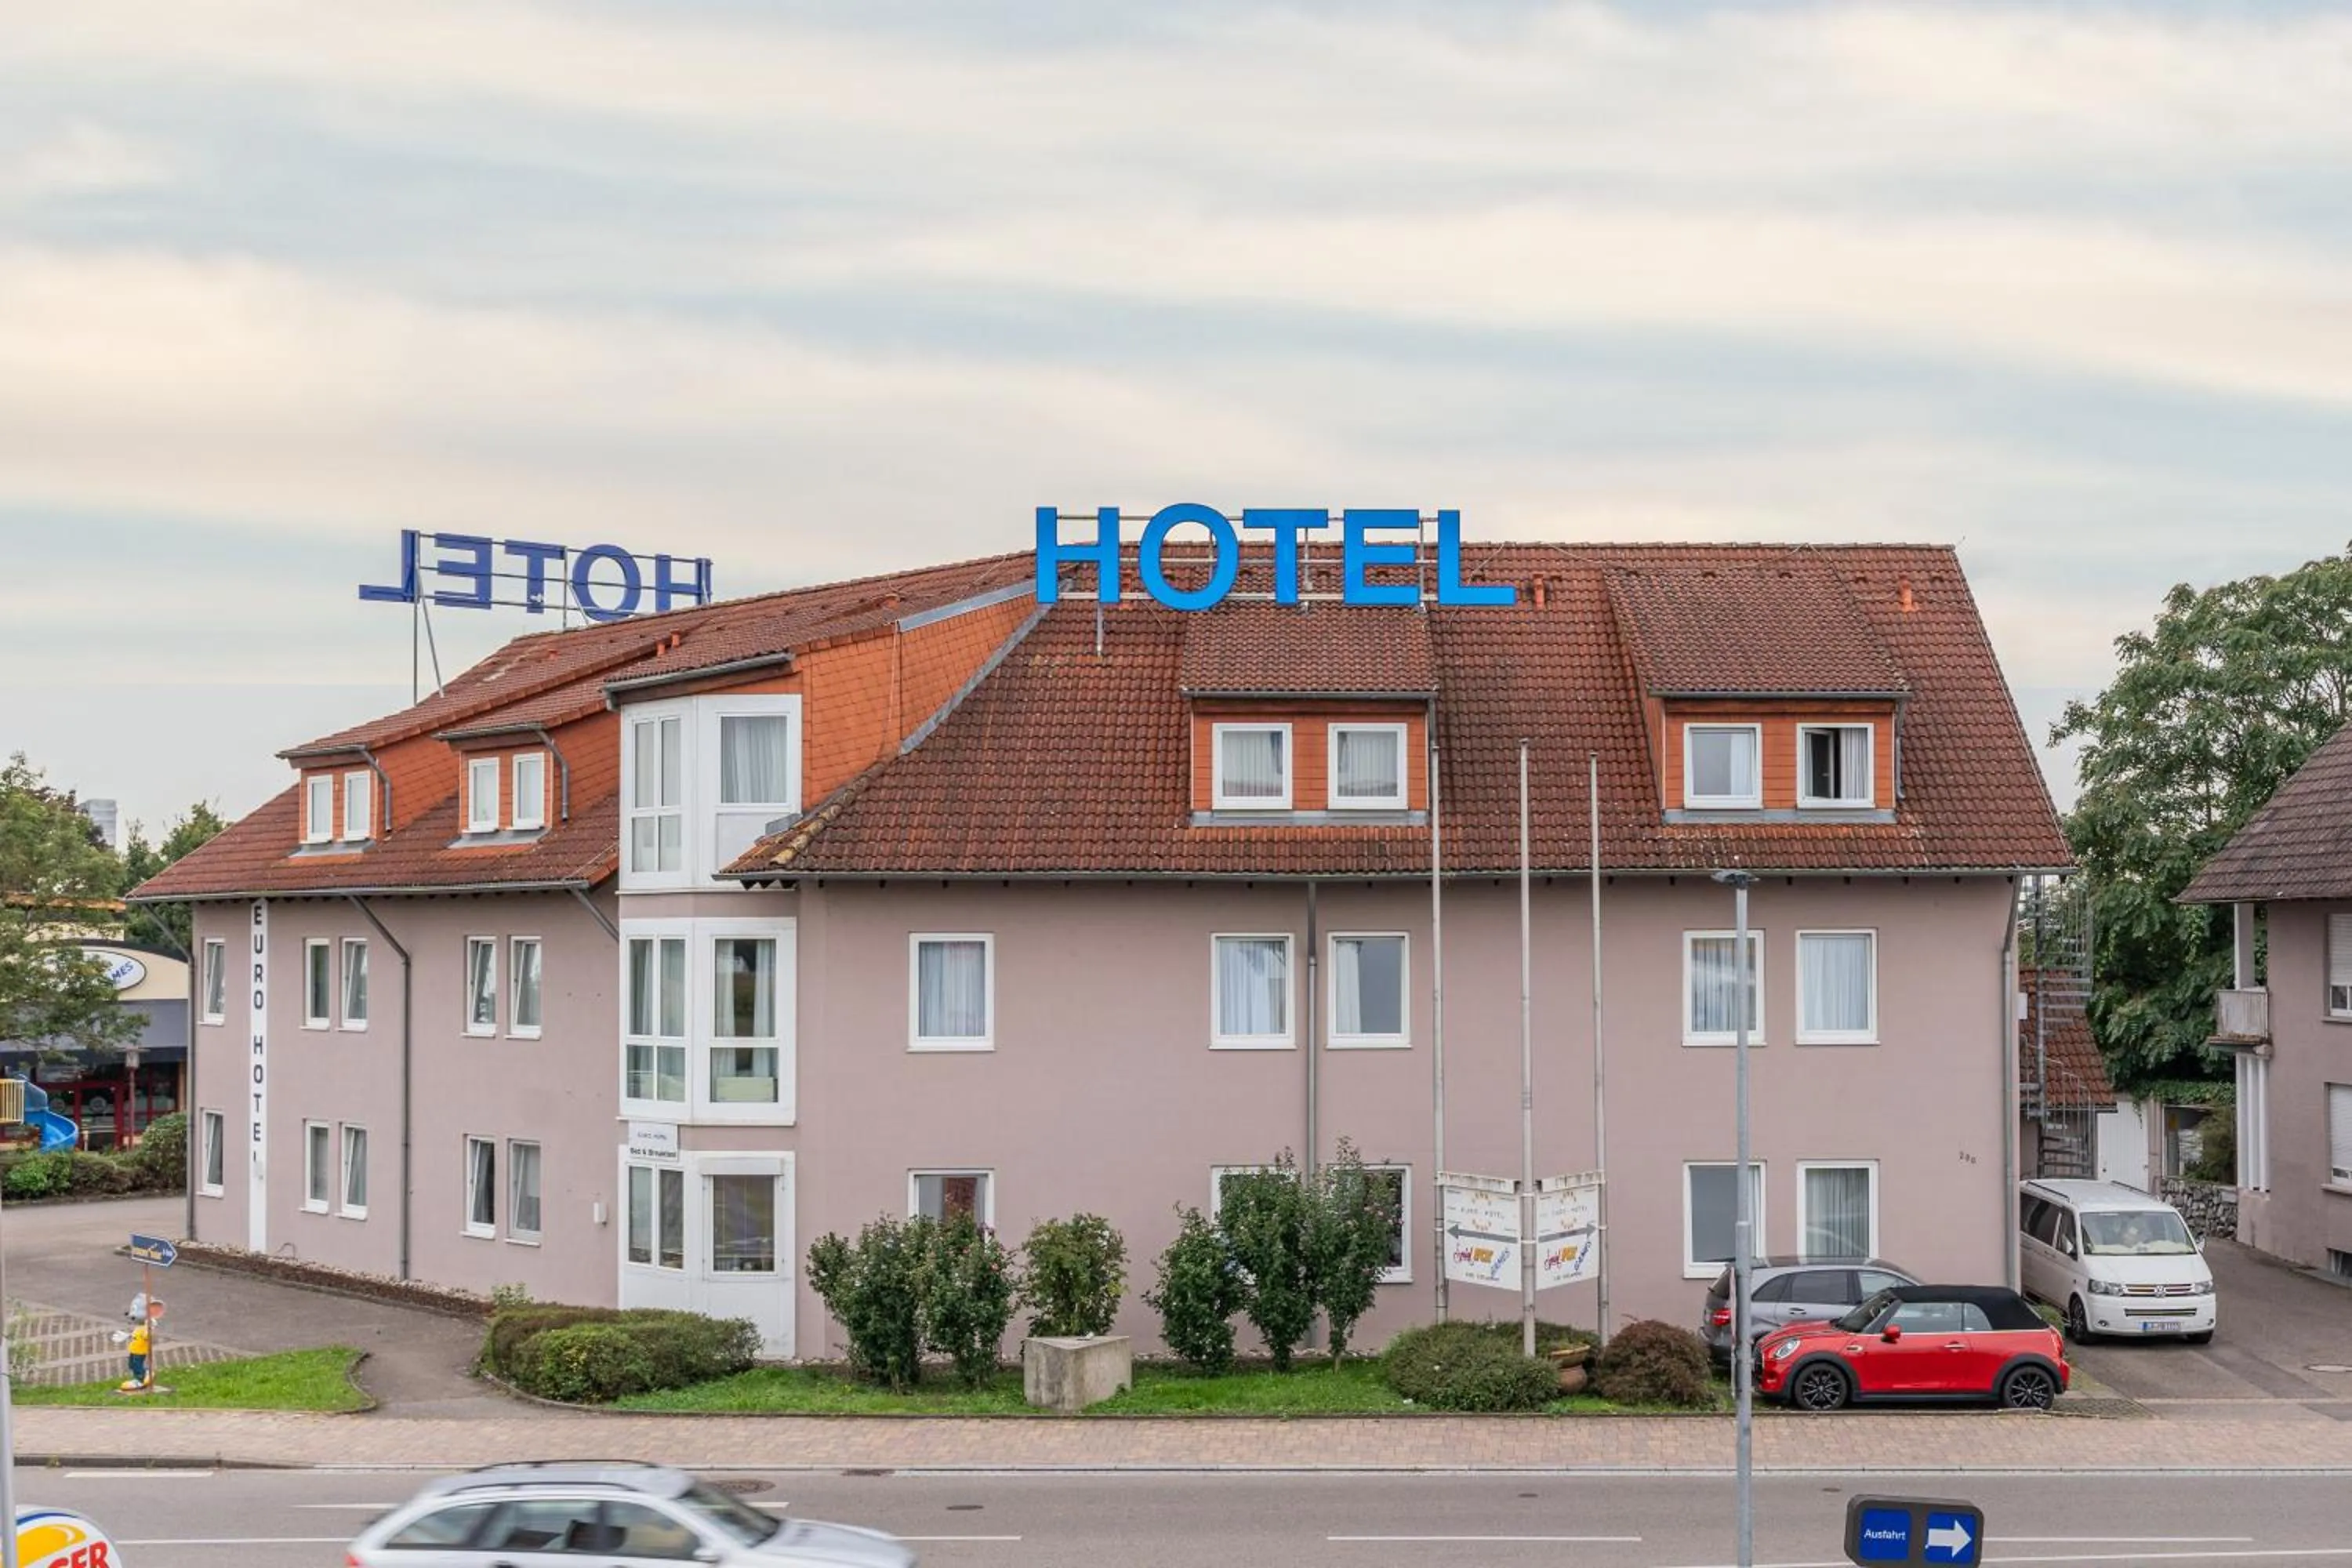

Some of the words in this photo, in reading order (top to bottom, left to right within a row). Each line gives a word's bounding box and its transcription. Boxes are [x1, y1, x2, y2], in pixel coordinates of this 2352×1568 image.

[1036, 503, 1515, 611] HOTEL
[253, 905, 263, 1010] EURO
[1864, 1528, 1906, 1541] Ausfahrt
